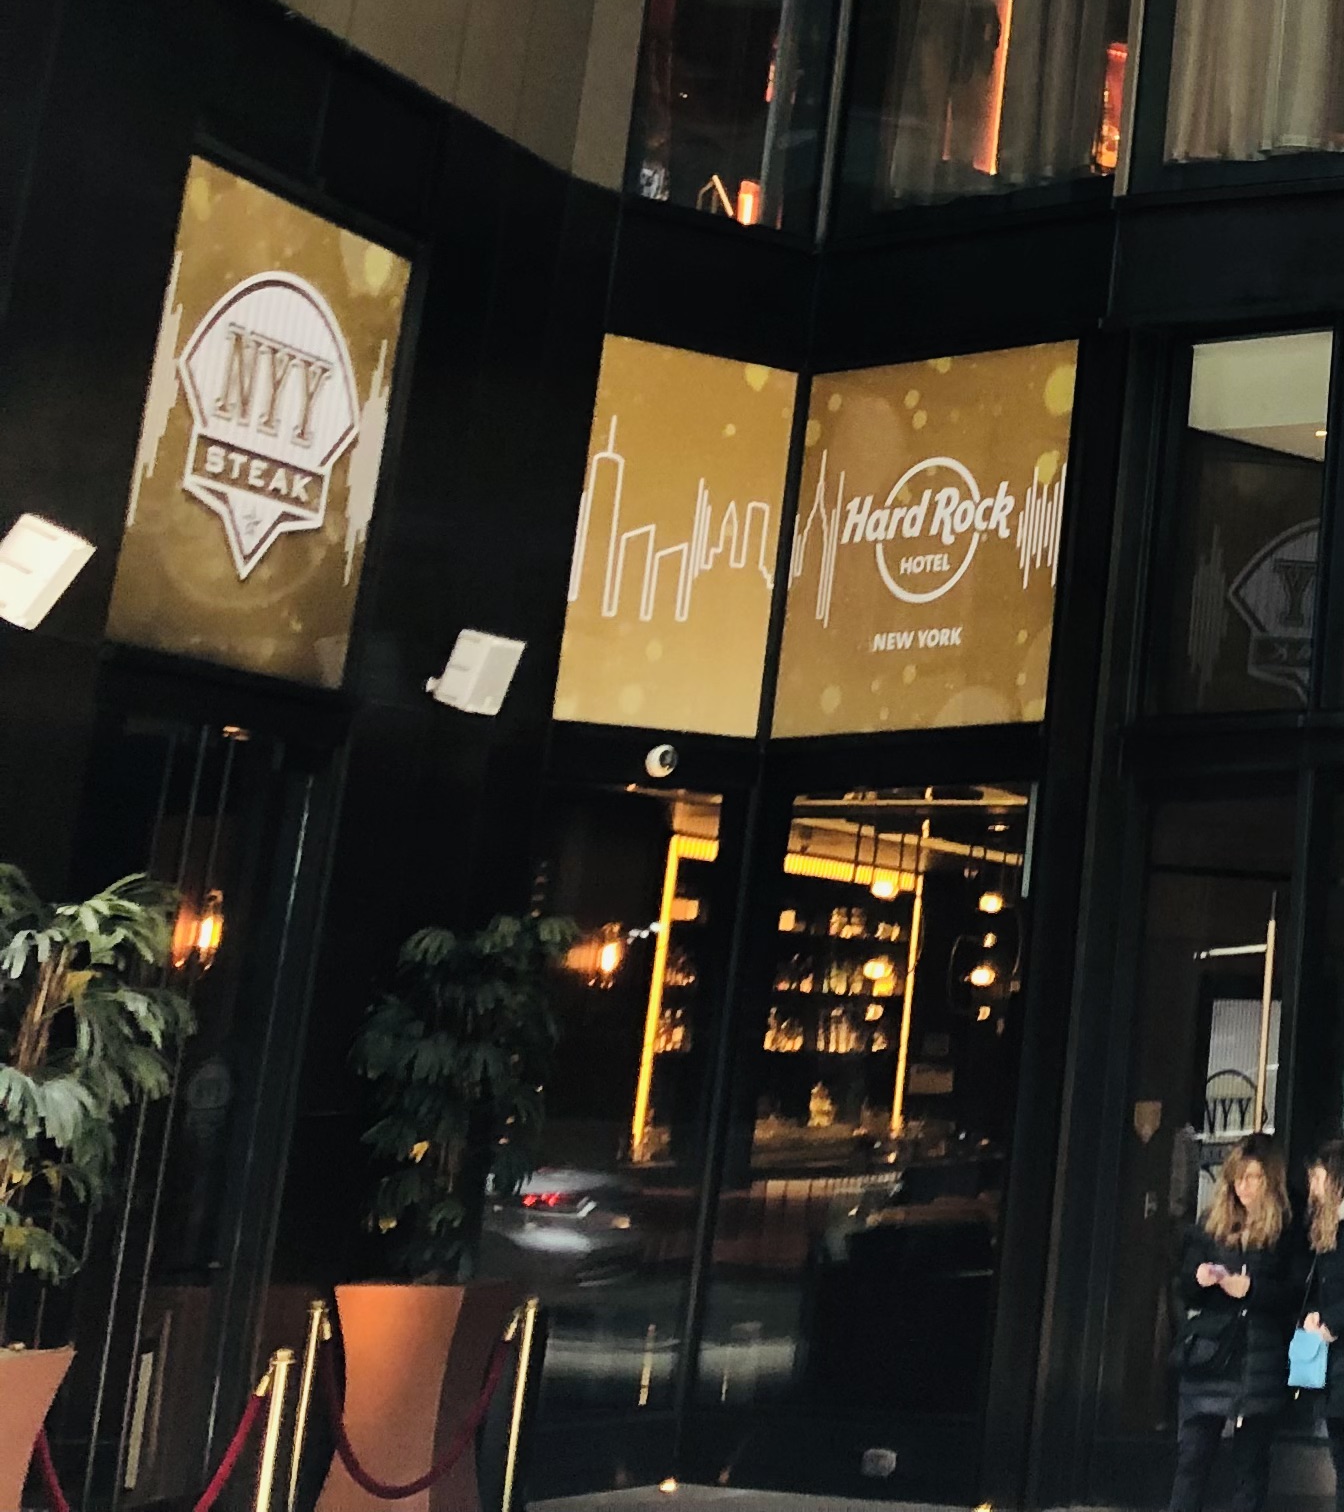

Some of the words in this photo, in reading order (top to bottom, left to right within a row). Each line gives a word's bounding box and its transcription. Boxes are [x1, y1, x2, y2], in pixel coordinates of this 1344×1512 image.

[215, 322, 334, 449] NYY
[205, 445, 313, 502] STEAK
[840, 489, 933, 544] Hard
[929, 481, 1015, 546] Rock
[900, 553, 951, 575] HOTEL
[872, 630, 914, 652] NEW
[917, 627, 963, 648] YORK
